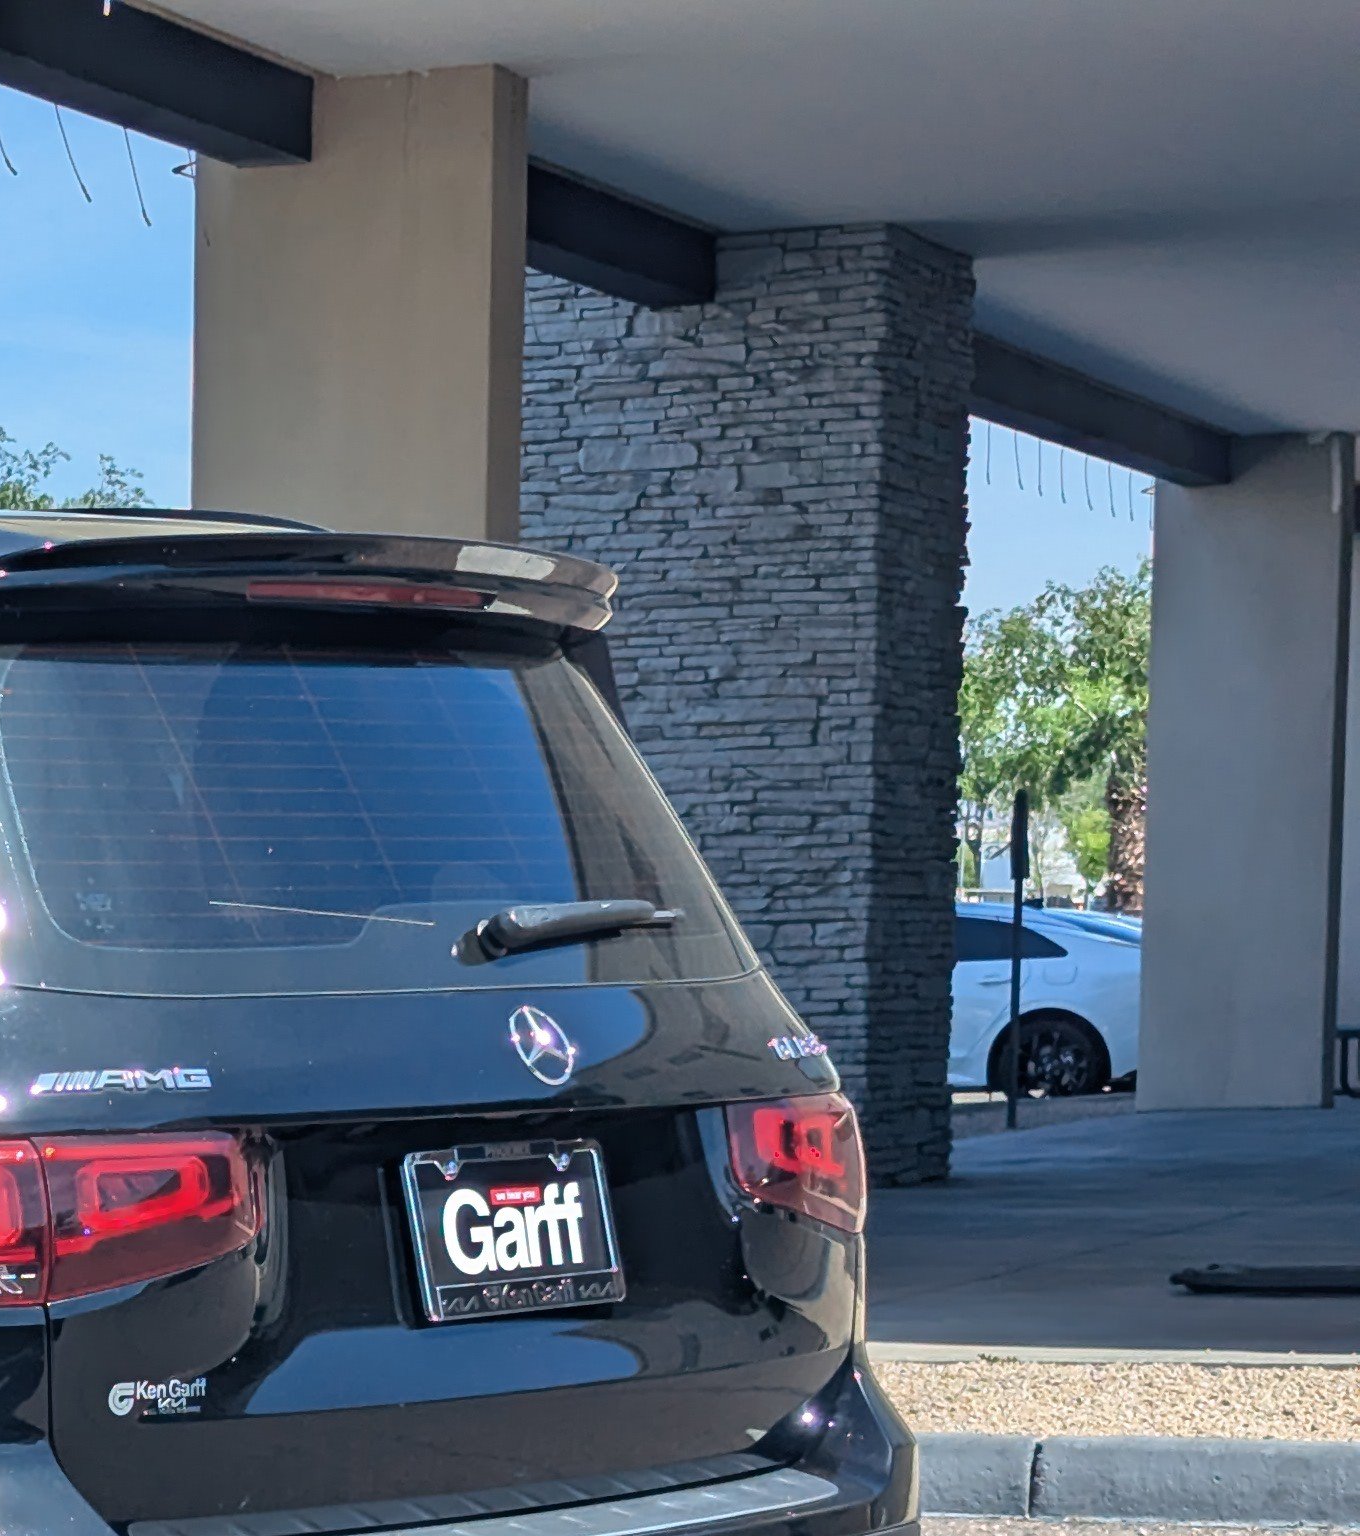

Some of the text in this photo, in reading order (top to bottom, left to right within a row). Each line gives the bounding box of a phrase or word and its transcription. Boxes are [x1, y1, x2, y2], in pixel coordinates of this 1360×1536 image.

[92, 1068, 212, 1091] AMG
[443, 1182, 584, 1276] Garff
[136, 1380, 167, 1400] Ken
[168, 1377, 207, 1398] Garff
